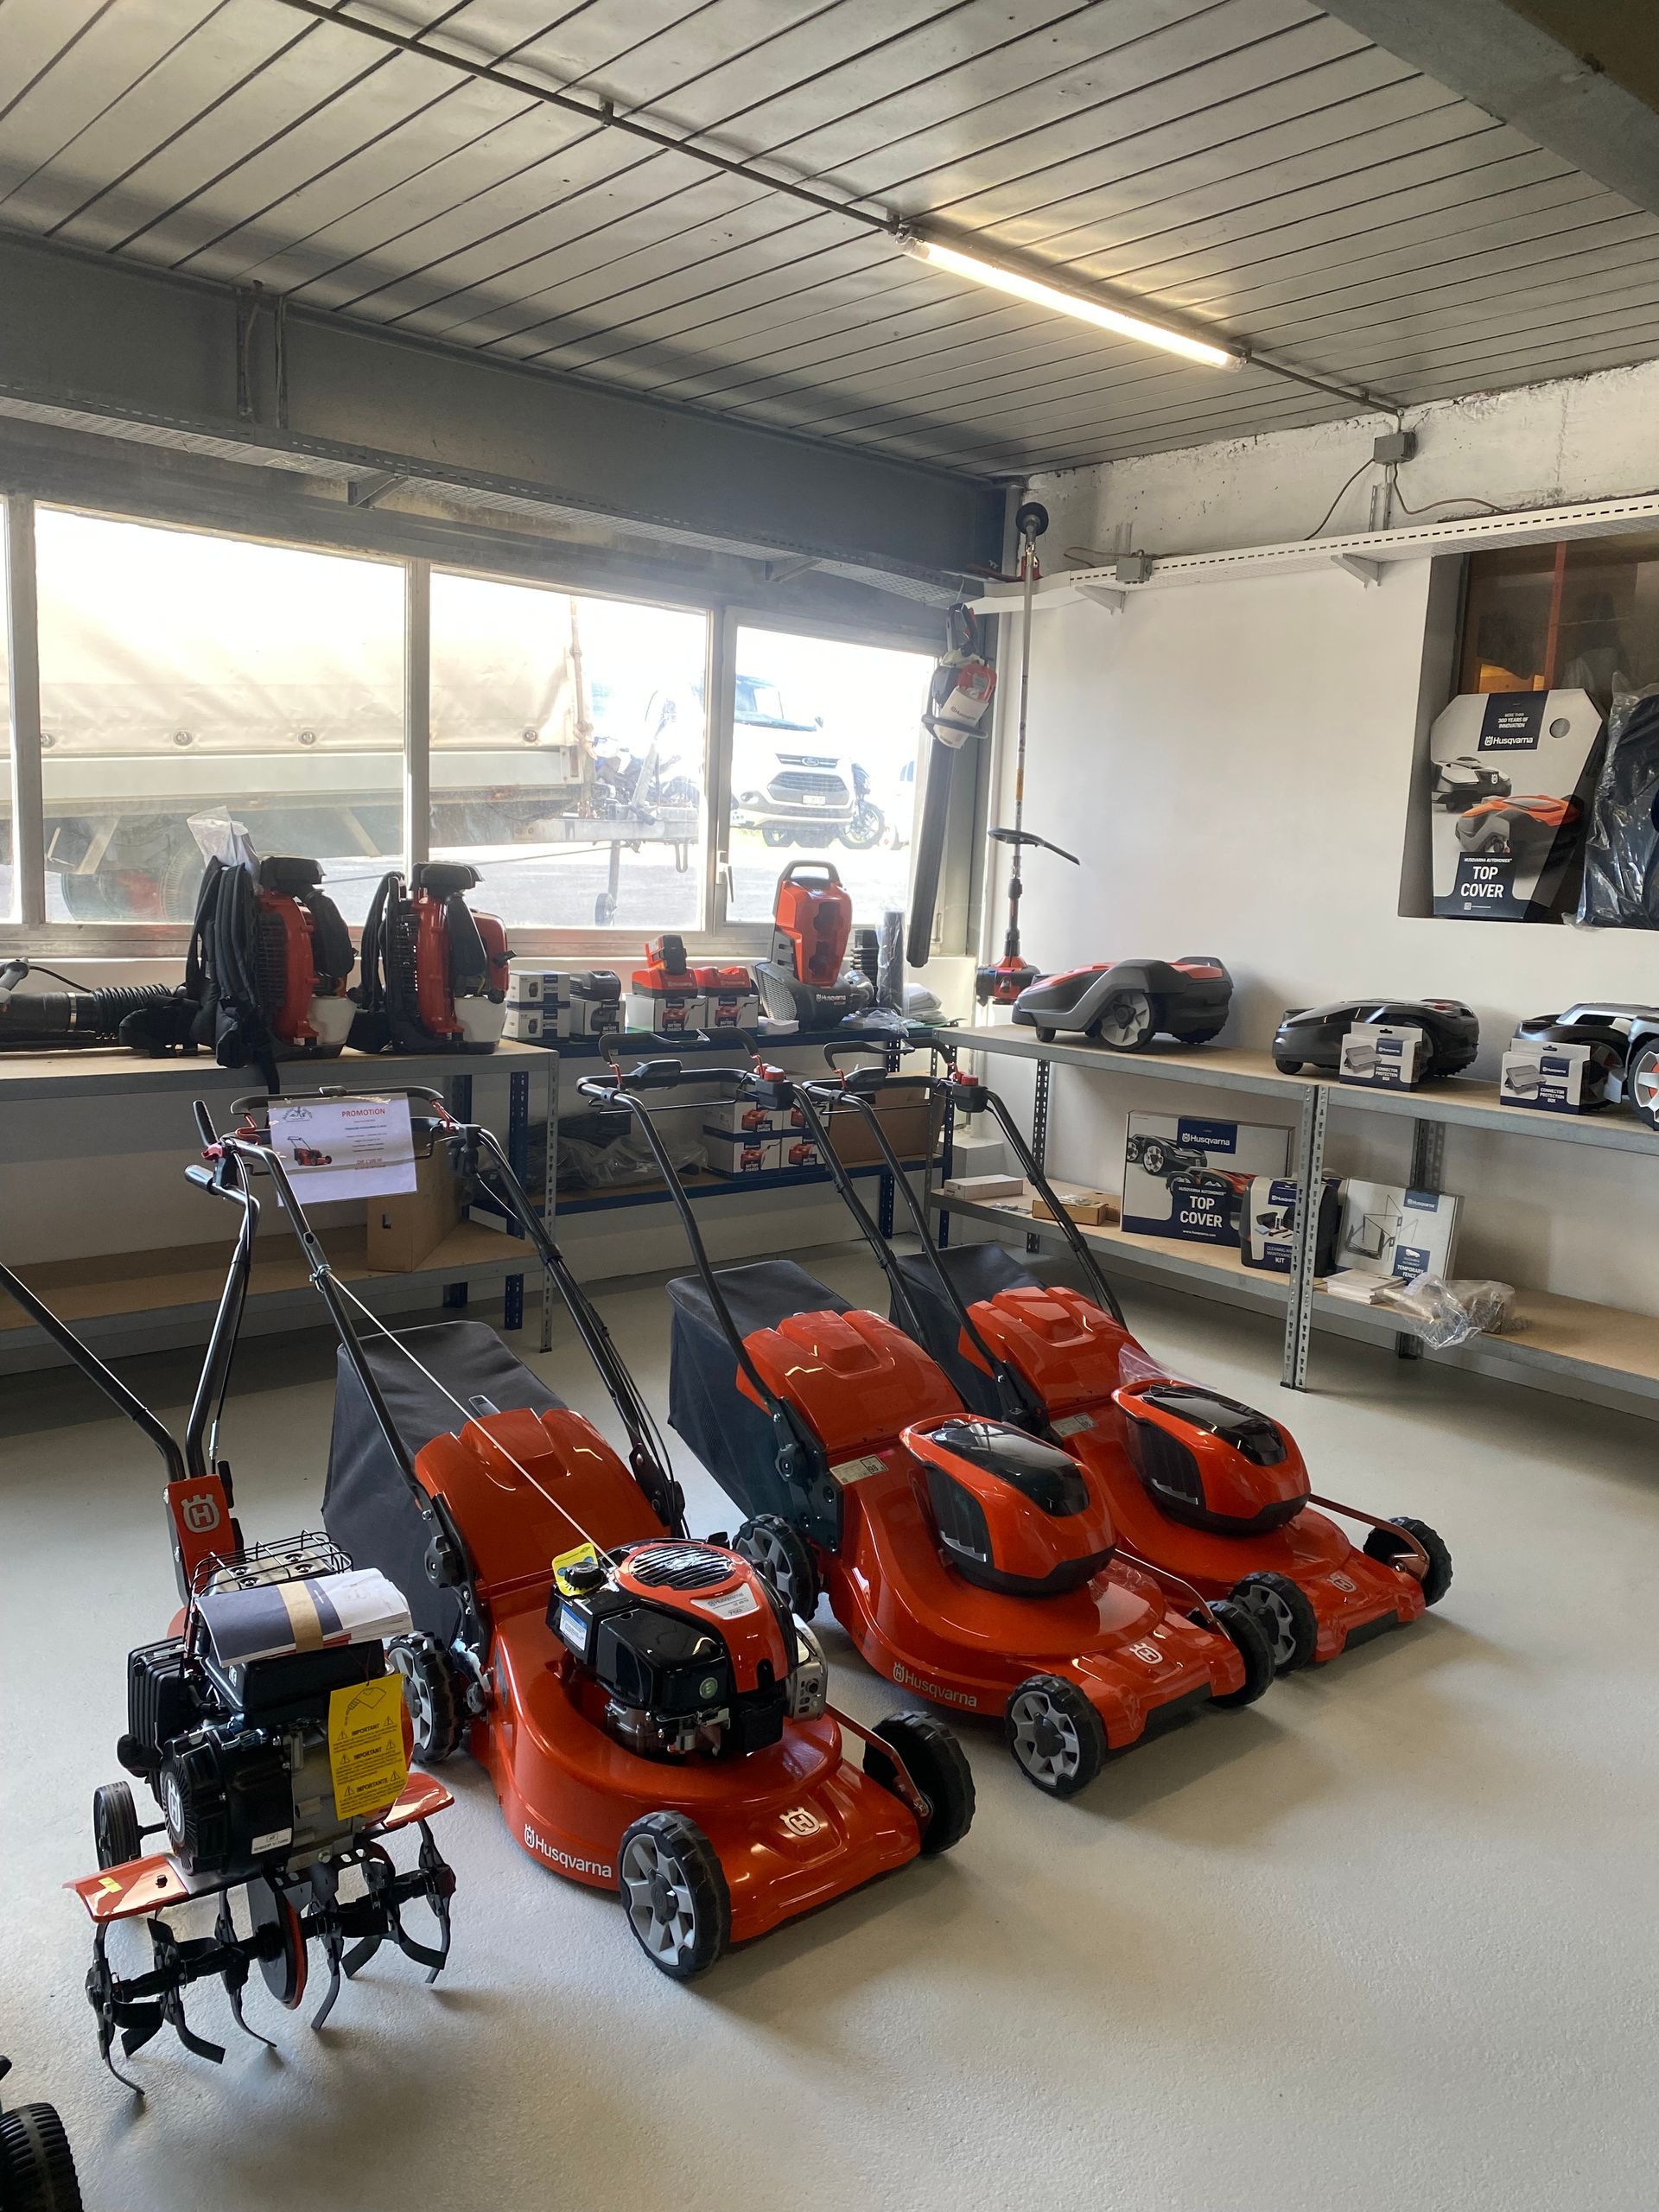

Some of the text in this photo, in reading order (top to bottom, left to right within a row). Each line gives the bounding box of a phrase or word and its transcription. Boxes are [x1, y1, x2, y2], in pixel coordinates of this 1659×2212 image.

[1493, 736, 1533, 745] Husqvarna
[1472, 866, 1498, 880] TOP
[1460, 883, 1504, 898] COVER
[341, 1109, 385, 1117] PROMOTION
[1190, 1135, 1230, 1146] Husqvarna
[1189, 1195, 1215, 1211] TOP
[1179, 1211, 1223, 1228] COVER
[1397, 1264, 1424, 1274] TEMPORARY
[905, 1669, 977, 1707] Husqvarna
[351, 1723, 380, 1736] IMPORTANT
[353, 1746, 383, 1760] IMPORTANT
[356, 1777, 388, 1793] IMPORTANTE
[536, 1834, 613, 1878] Husqvarna
